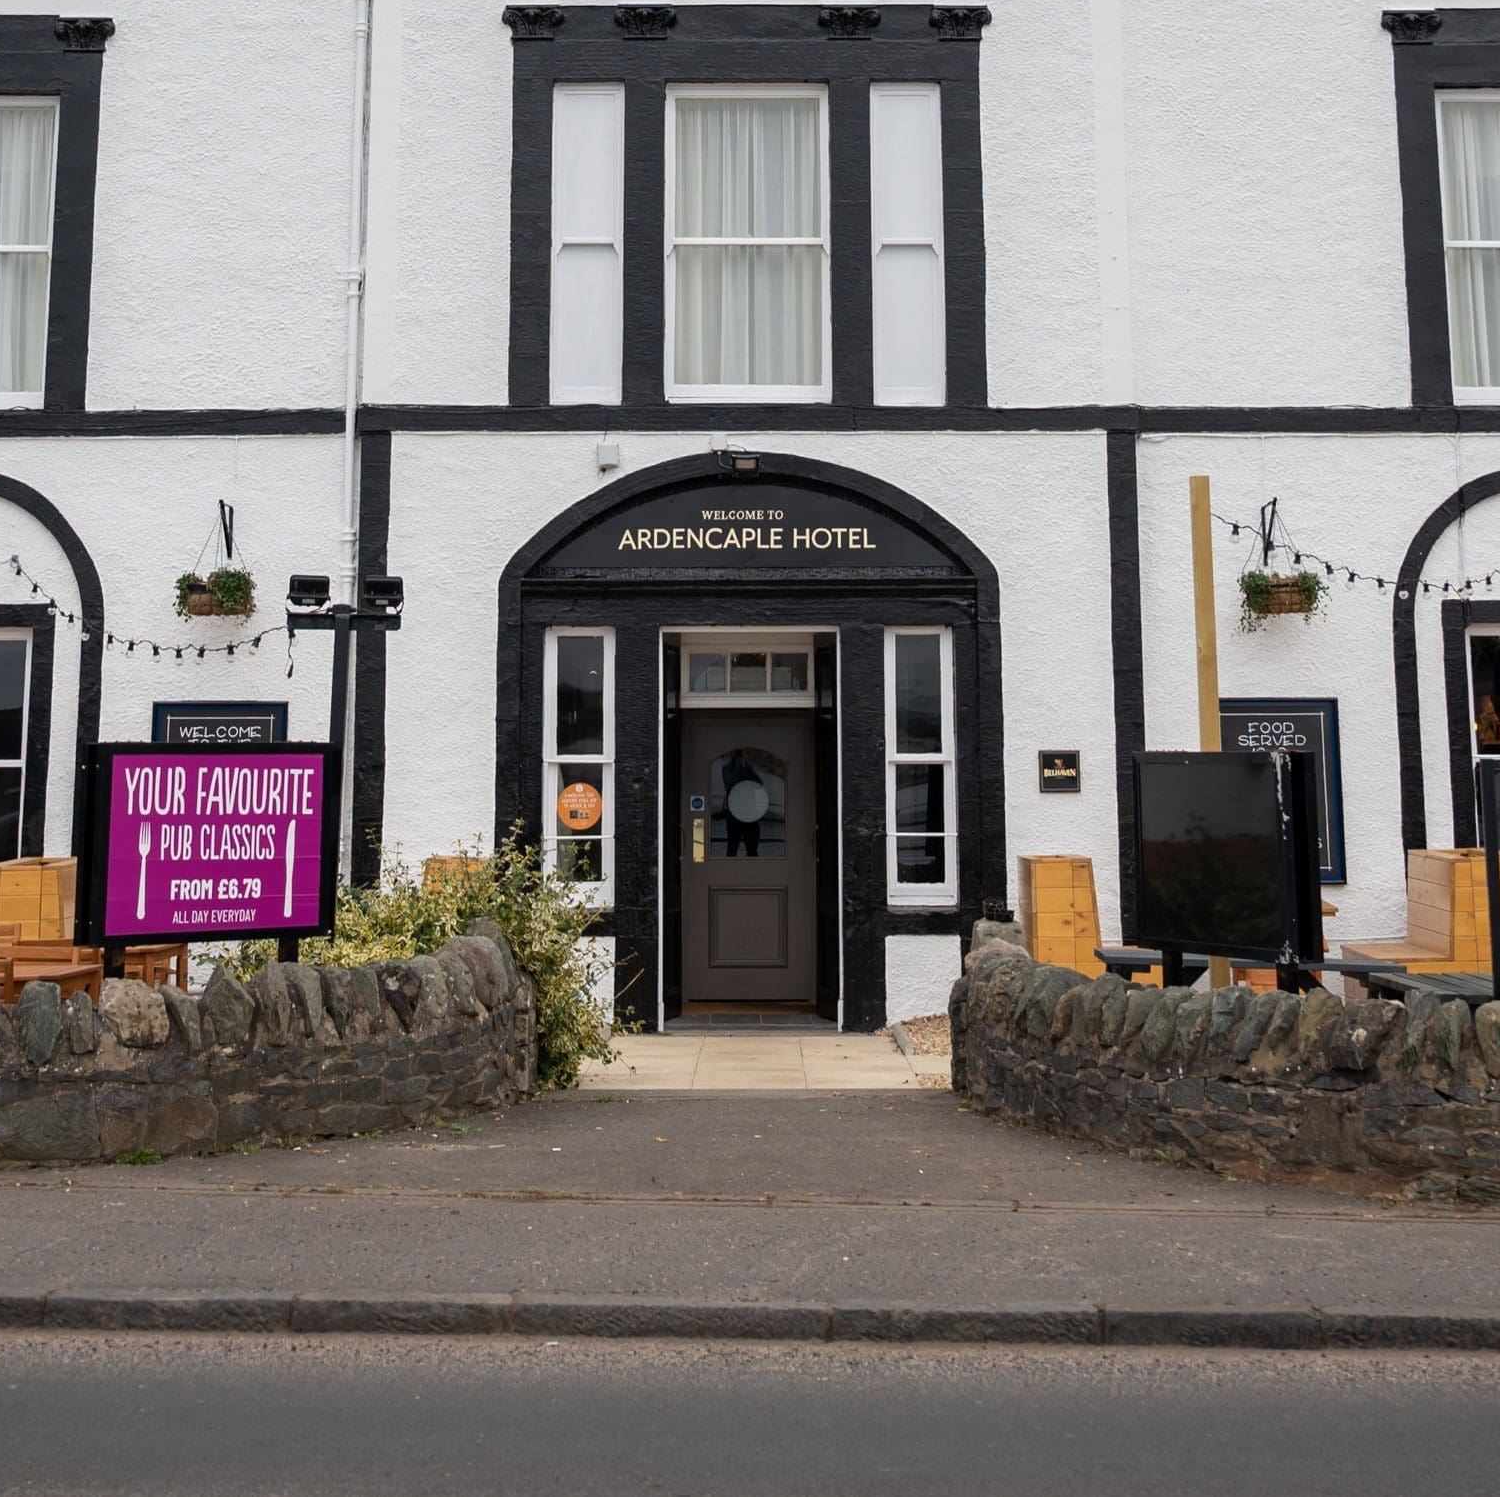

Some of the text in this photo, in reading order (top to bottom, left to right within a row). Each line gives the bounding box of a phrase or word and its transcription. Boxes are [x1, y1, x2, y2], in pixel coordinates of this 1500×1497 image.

[701, 509, 785, 521] WELCOME TO
[618, 527, 877, 550] ARDENCAPLE HOTEL
[179, 726, 262, 738] WELCOME
[1247, 722, 1295, 734] FOOD
[1238, 734, 1307, 747] SERVED
[124, 766, 315, 816] YOUR FAVOURITE
[160, 824, 276, 861] PUB CLASSICS
[170, 877, 262, 901] FROM £6.79
[172, 908, 257, 925] ALL DAY EVERYDAY
